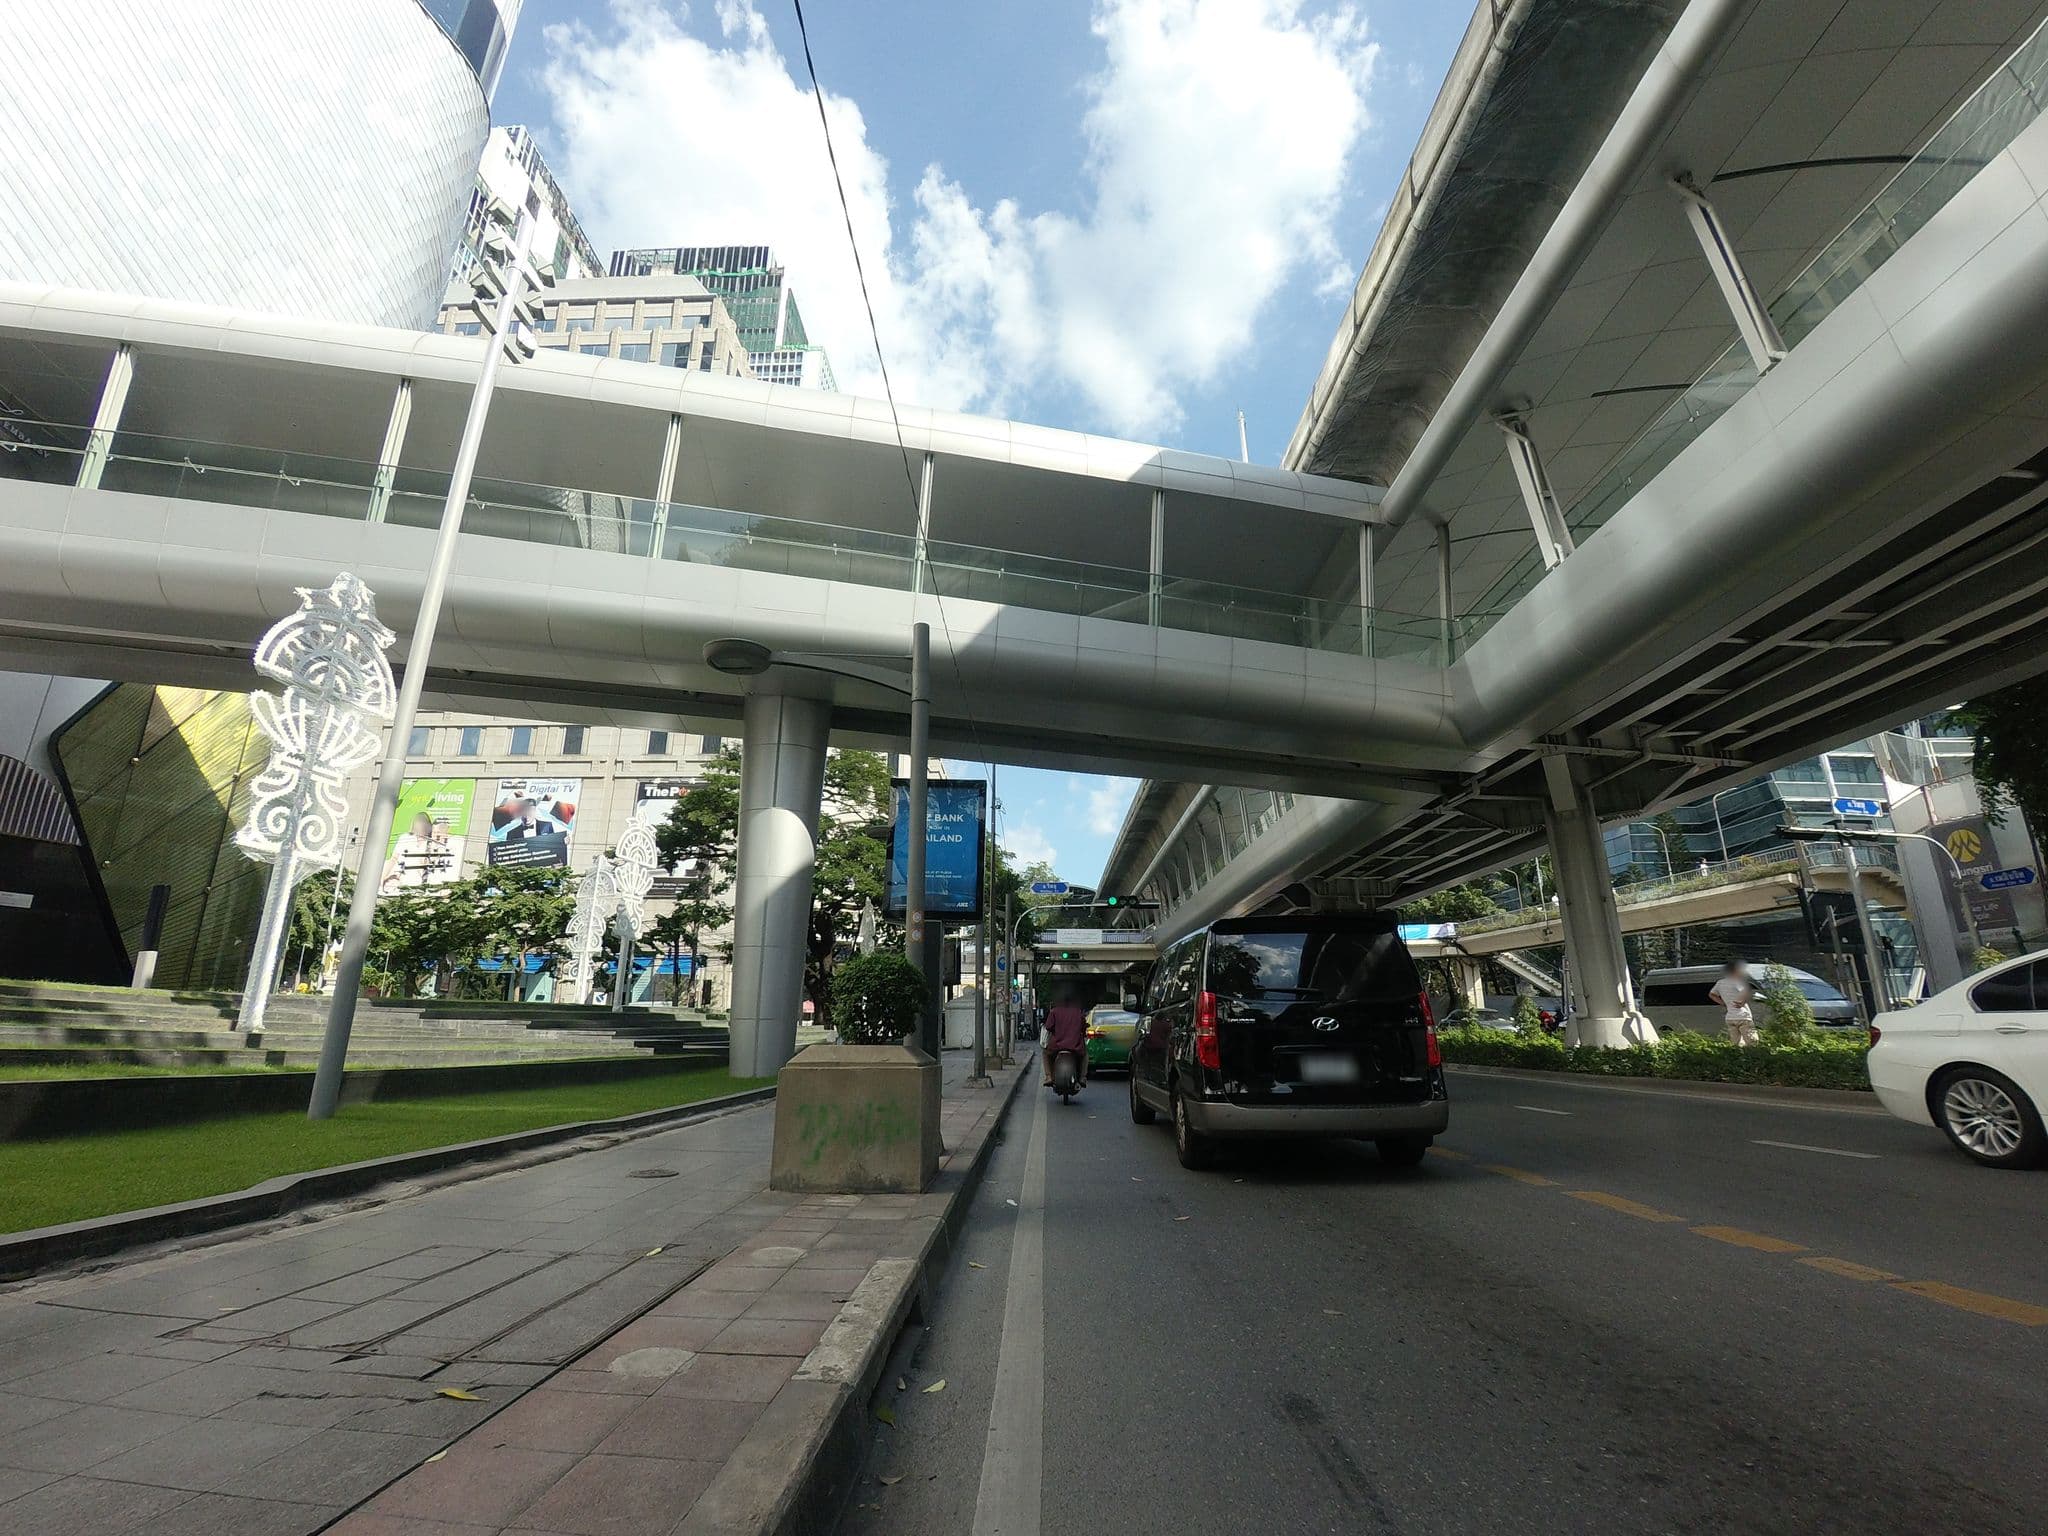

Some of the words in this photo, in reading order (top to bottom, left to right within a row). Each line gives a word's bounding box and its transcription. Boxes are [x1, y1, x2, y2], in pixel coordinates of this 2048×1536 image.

[528, 785, 558, 794] Digital
[563, 785, 576, 793] TV
[435, 792, 464, 805] living
[934, 813, 964, 822] BANK
[926, 834, 963, 843] AILAND
[1949, 862, 1994, 878] Kungsri
